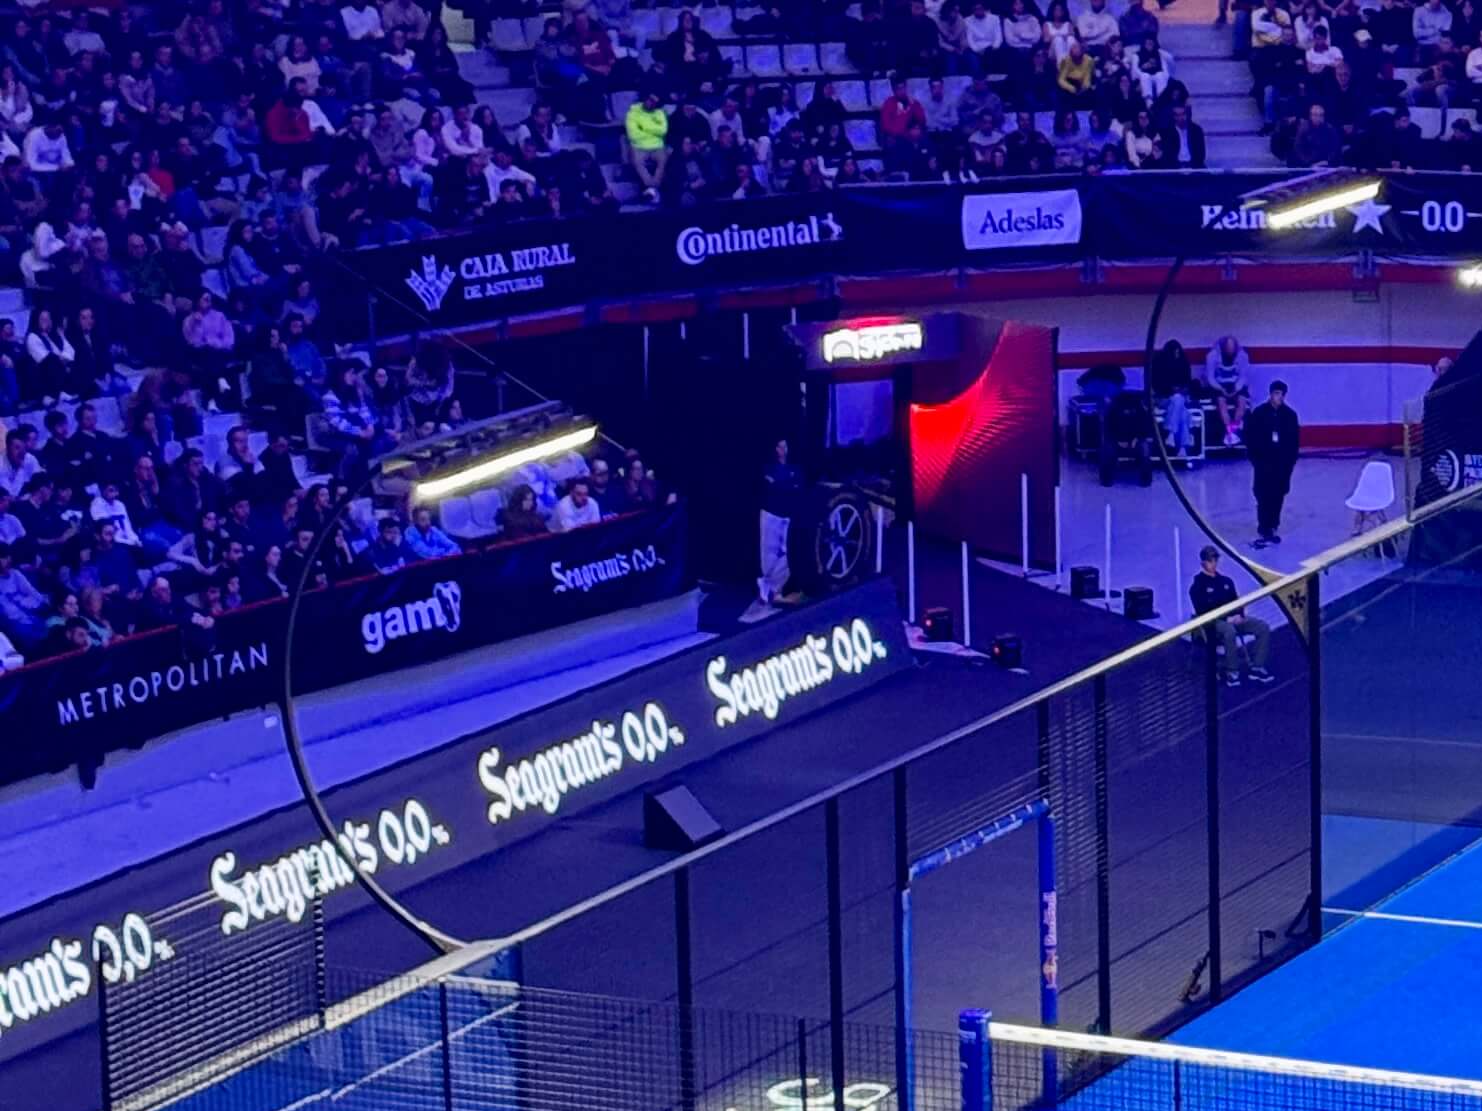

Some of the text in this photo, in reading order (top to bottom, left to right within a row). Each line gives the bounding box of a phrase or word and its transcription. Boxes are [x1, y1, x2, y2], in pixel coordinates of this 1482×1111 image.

[676, 215, 820, 266] Continental
[979, 206, 1065, 235] Adeslas
[460, 243, 576, 280] CAJA RURAL
[57, 642, 269, 726] METROPOLITAN
[707, 634, 833, 728] Seagram's
[478, 720, 623, 825] Seagram's
